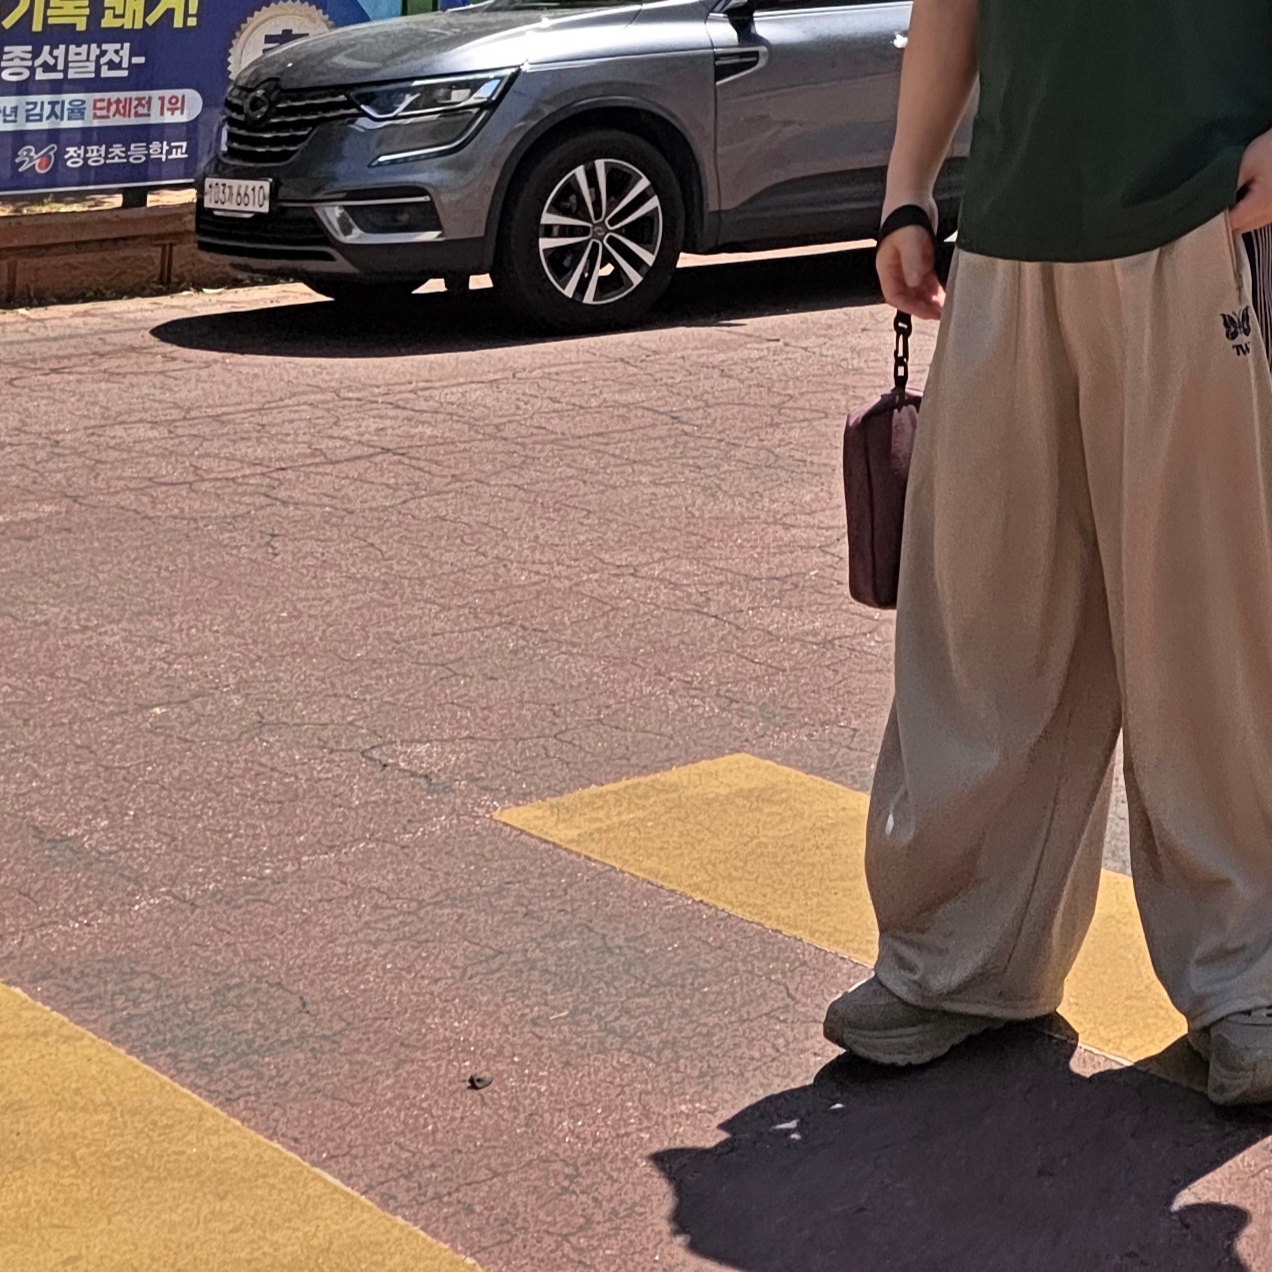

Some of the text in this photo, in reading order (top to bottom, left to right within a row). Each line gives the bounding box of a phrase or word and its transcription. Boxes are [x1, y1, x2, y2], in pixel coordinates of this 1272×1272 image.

[0, 94, 186, 124] 년 김지율 단체전 1위
[64, 141, 189, 168] 정평초등학교
